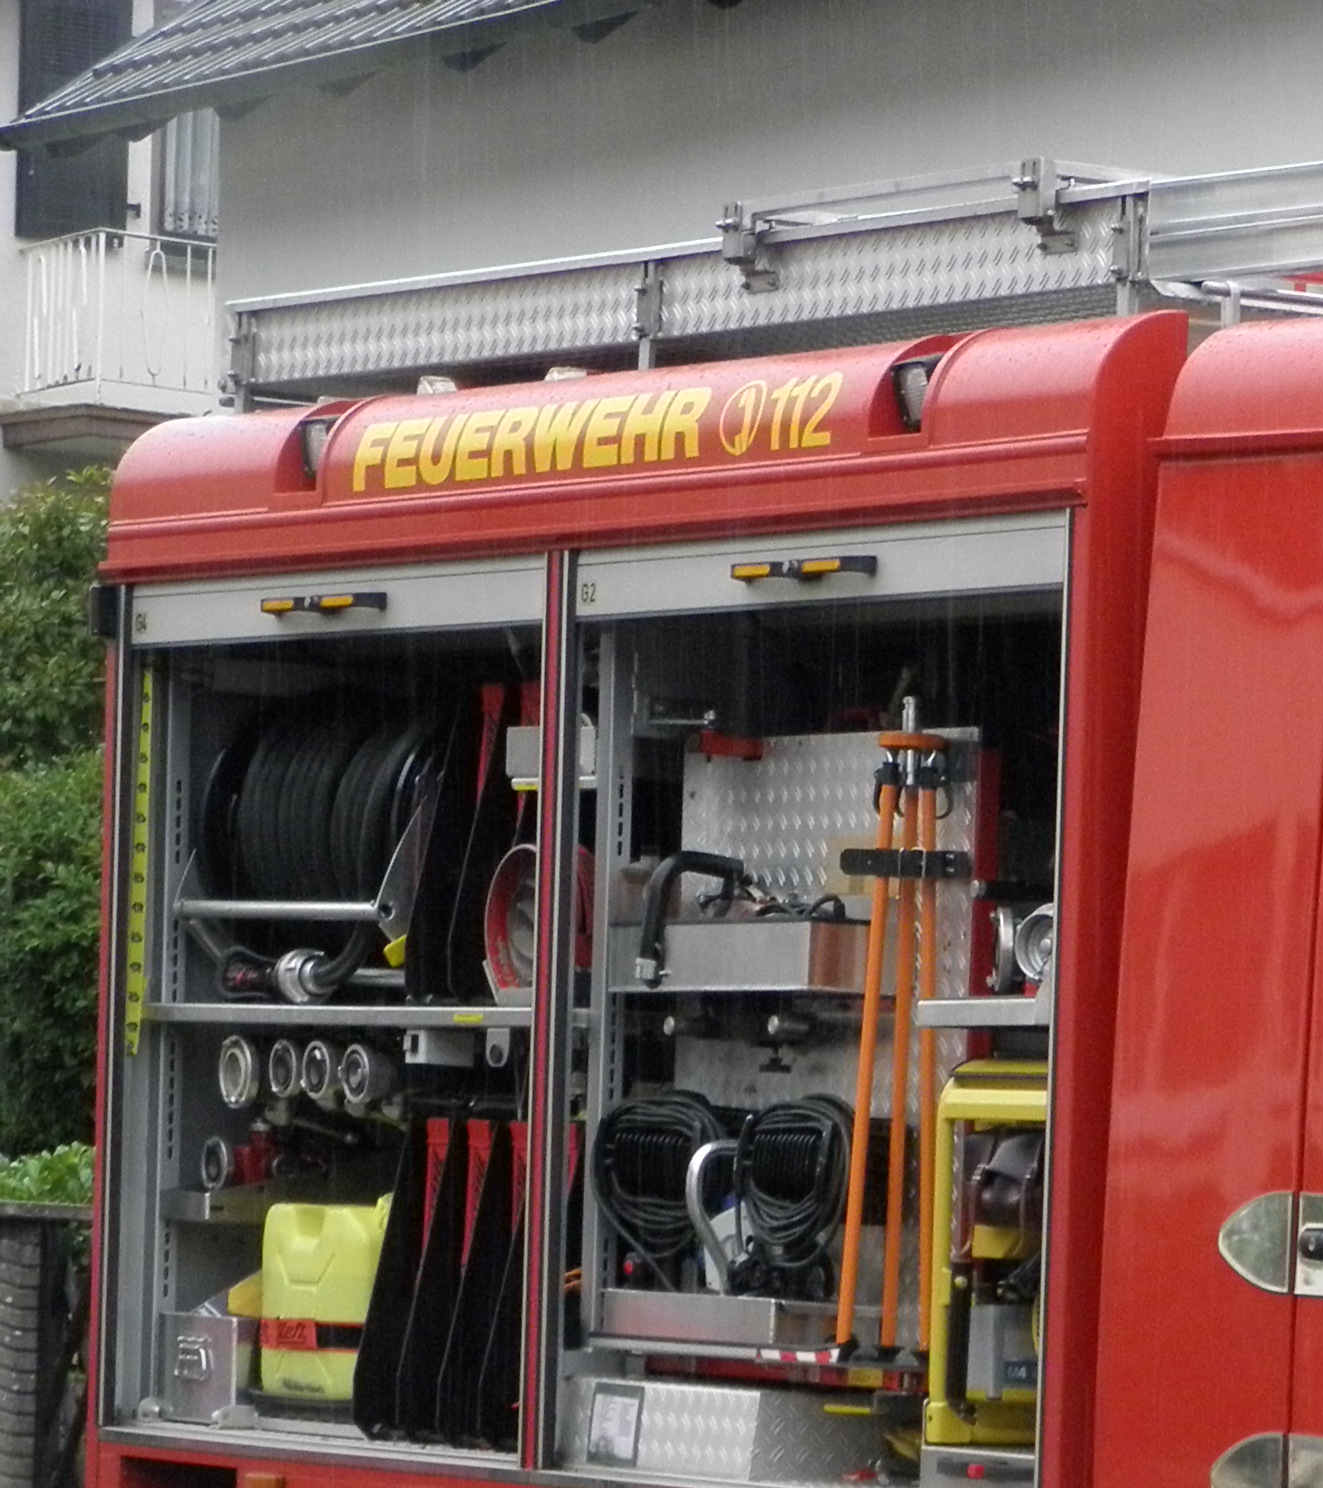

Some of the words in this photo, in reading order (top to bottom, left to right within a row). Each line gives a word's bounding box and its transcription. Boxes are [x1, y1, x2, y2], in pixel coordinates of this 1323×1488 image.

[352, 386, 713, 492] FEUERWEHR
[769, 371, 844, 451] 112
[581, 582, 597, 603] G2
